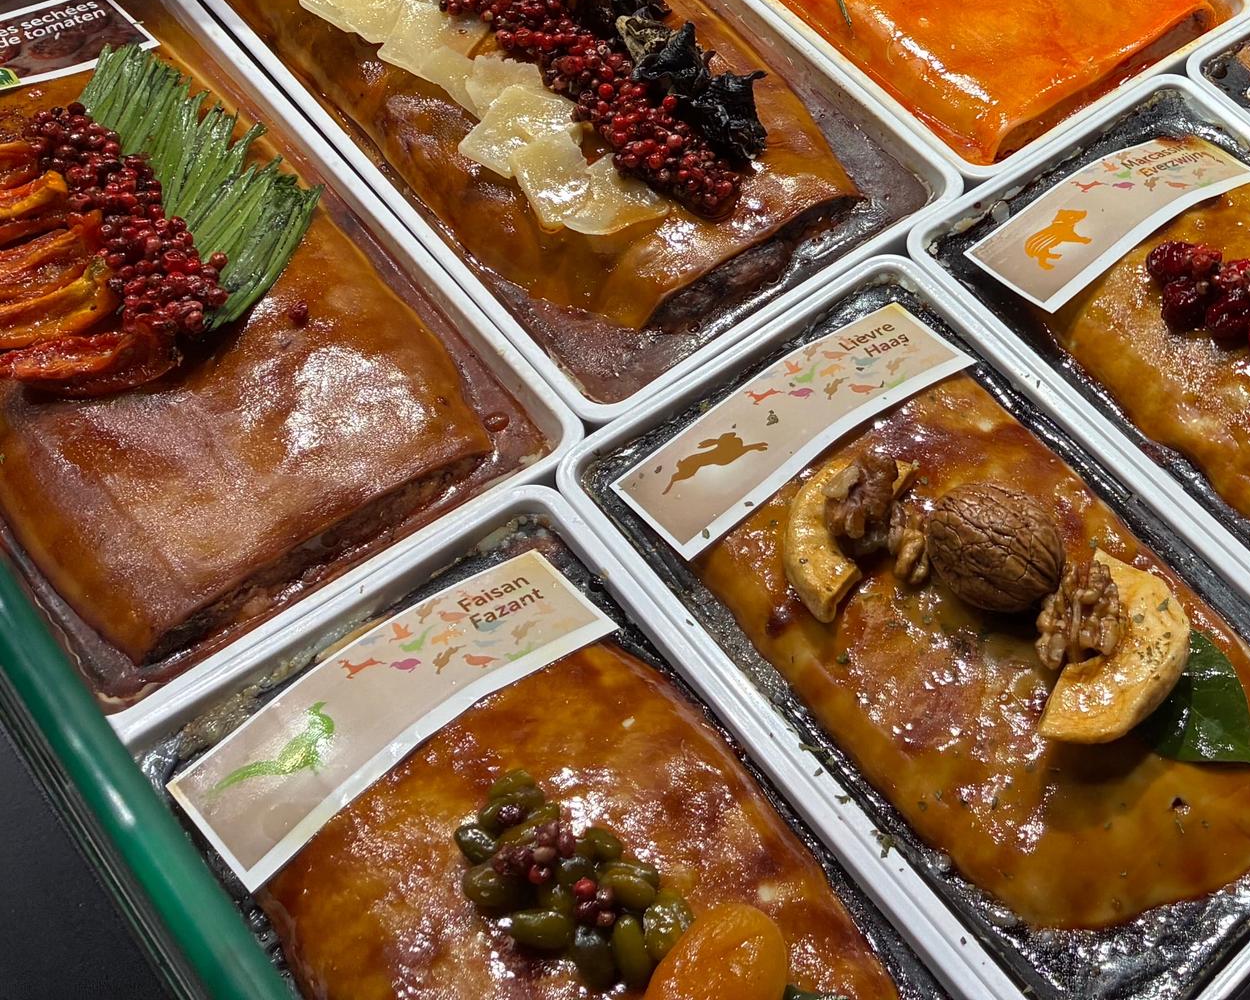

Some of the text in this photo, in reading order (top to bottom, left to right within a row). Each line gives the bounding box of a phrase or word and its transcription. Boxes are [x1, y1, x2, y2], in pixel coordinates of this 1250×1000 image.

[24, 8, 106, 40] tomaten
[1139, 151, 1208, 178] Everzwijn
[838, 321, 896, 352] Lièvre
[457, 573, 530, 615] Faisan
[470, 588, 545, 630] Fazant
